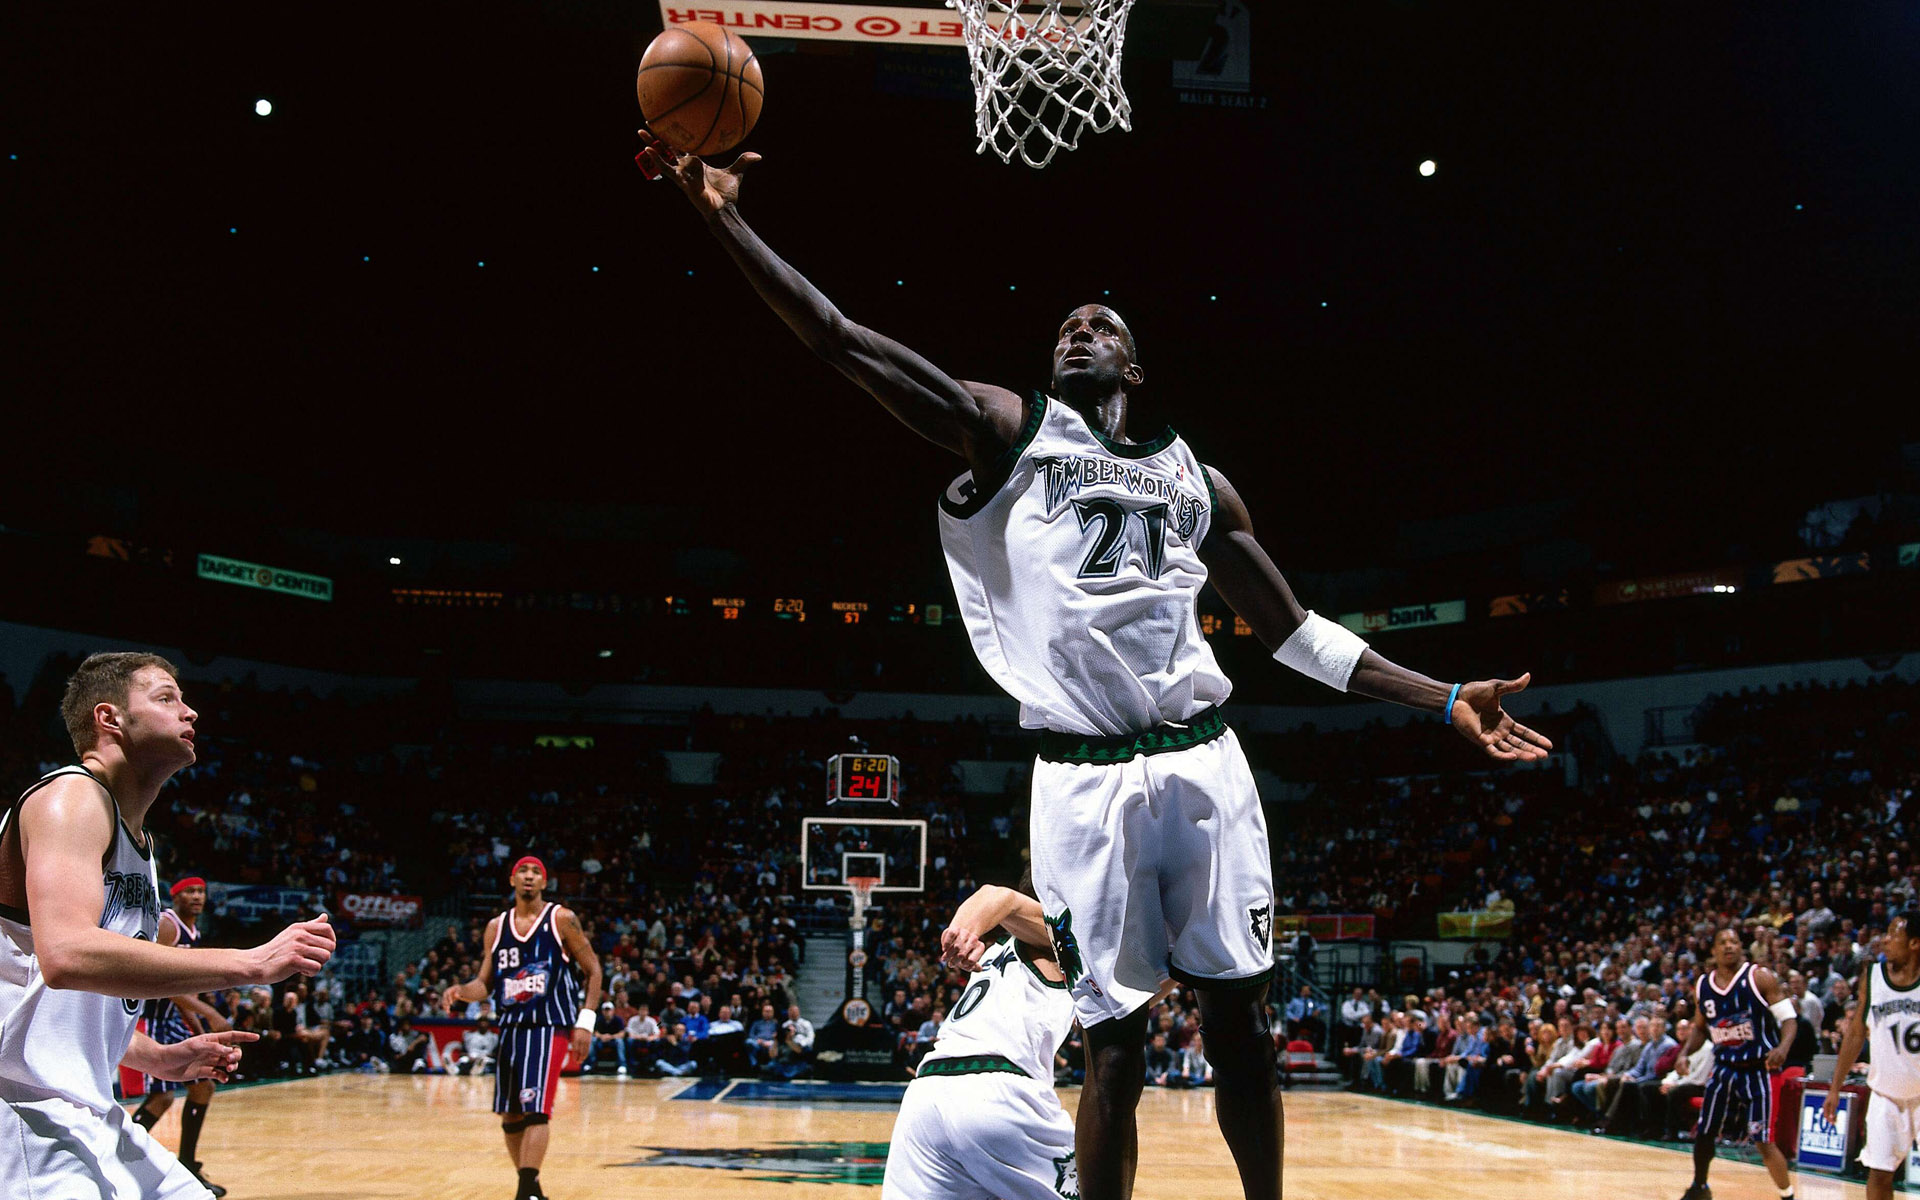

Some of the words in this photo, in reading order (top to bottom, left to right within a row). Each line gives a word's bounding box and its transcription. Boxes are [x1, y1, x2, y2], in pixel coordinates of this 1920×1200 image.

[667, 8, 843, 32] CENTER
[1032, 455, 1209, 541] TIMBERWOLVES
[1070, 498, 1169, 581] 21
[201, 558, 256, 580] TARGET
[274, 572, 329, 595] CENTER
[774, 598, 804, 613] 6:20
[844, 611, 860, 624] 57
[852, 758, 888, 772] 6:20
[848, 775, 881, 798] 24
[342, 893, 418, 914] Office
[498, 946, 520, 970] 33
[1704, 999, 1717, 1018] 3
[1888, 1021, 1920, 1055] 16
